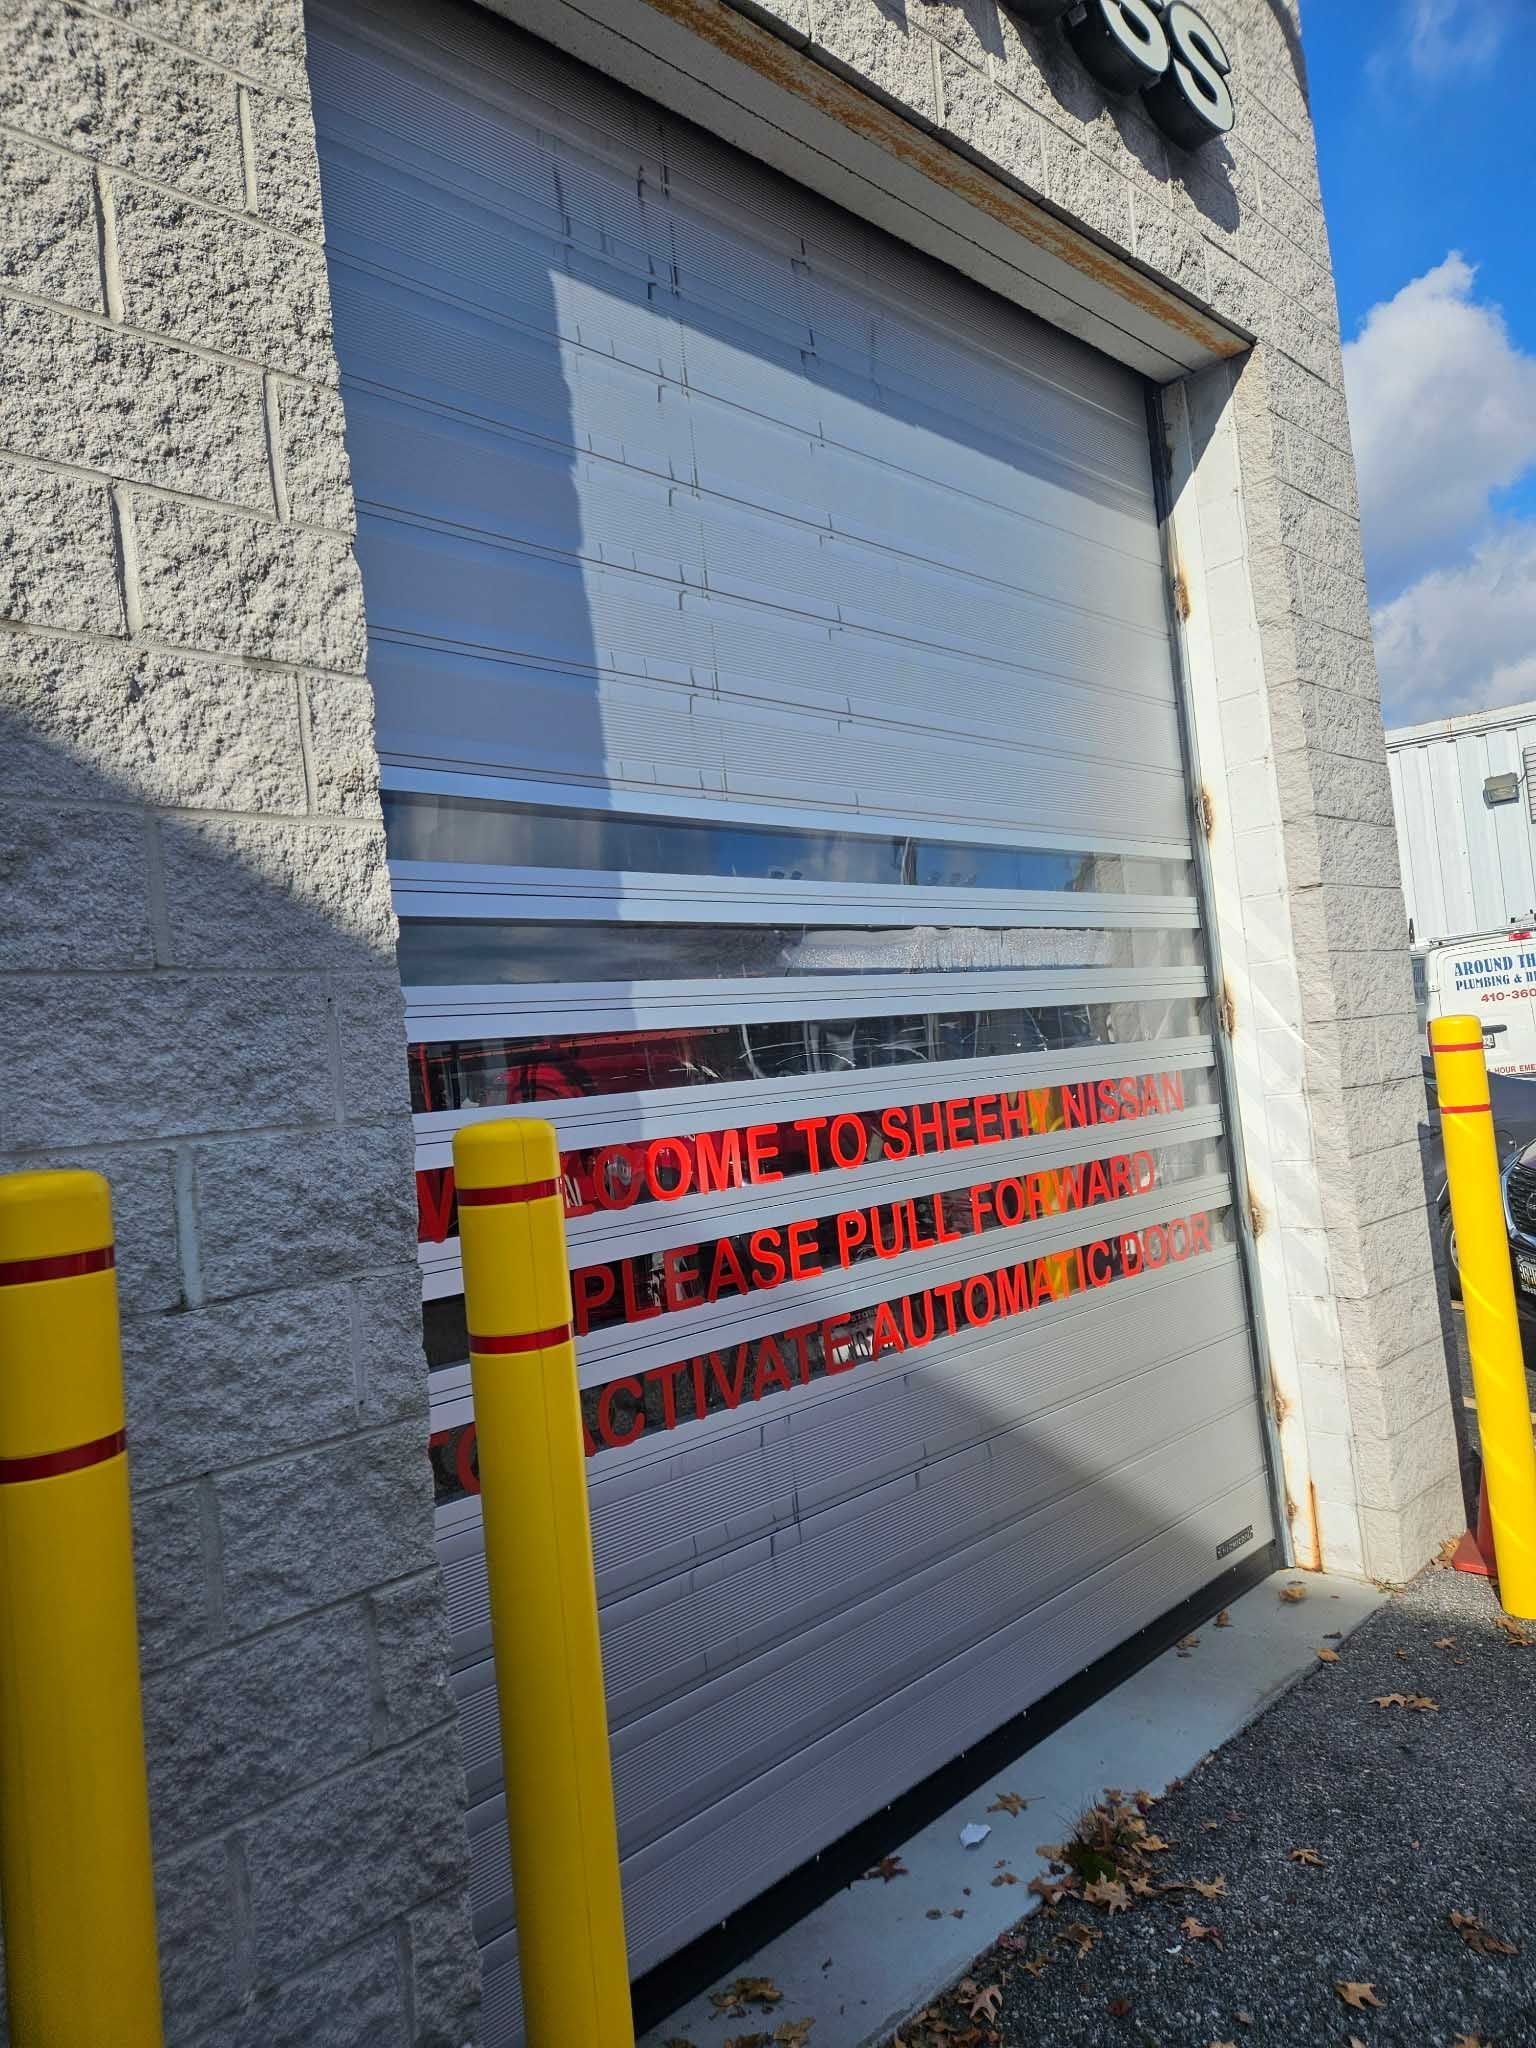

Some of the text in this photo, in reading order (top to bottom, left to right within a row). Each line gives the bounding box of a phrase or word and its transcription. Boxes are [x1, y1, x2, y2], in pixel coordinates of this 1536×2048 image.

[1455, 956, 1513, 976] AROUND
[1456, 974, 1510, 991] PLUMBING
[1514, 974, 1522, 983] &
[794, 1113, 868, 1178] TO
[881, 1088, 1051, 1163] SHEEHY
[1061, 1070, 1185, 1131] NISSAN
[572, 1150, 1156, 1336] PLEASE PULL FORWARD
[583, 1211, 1213, 1457] CTIVATE AUTOMATIC DOOR
